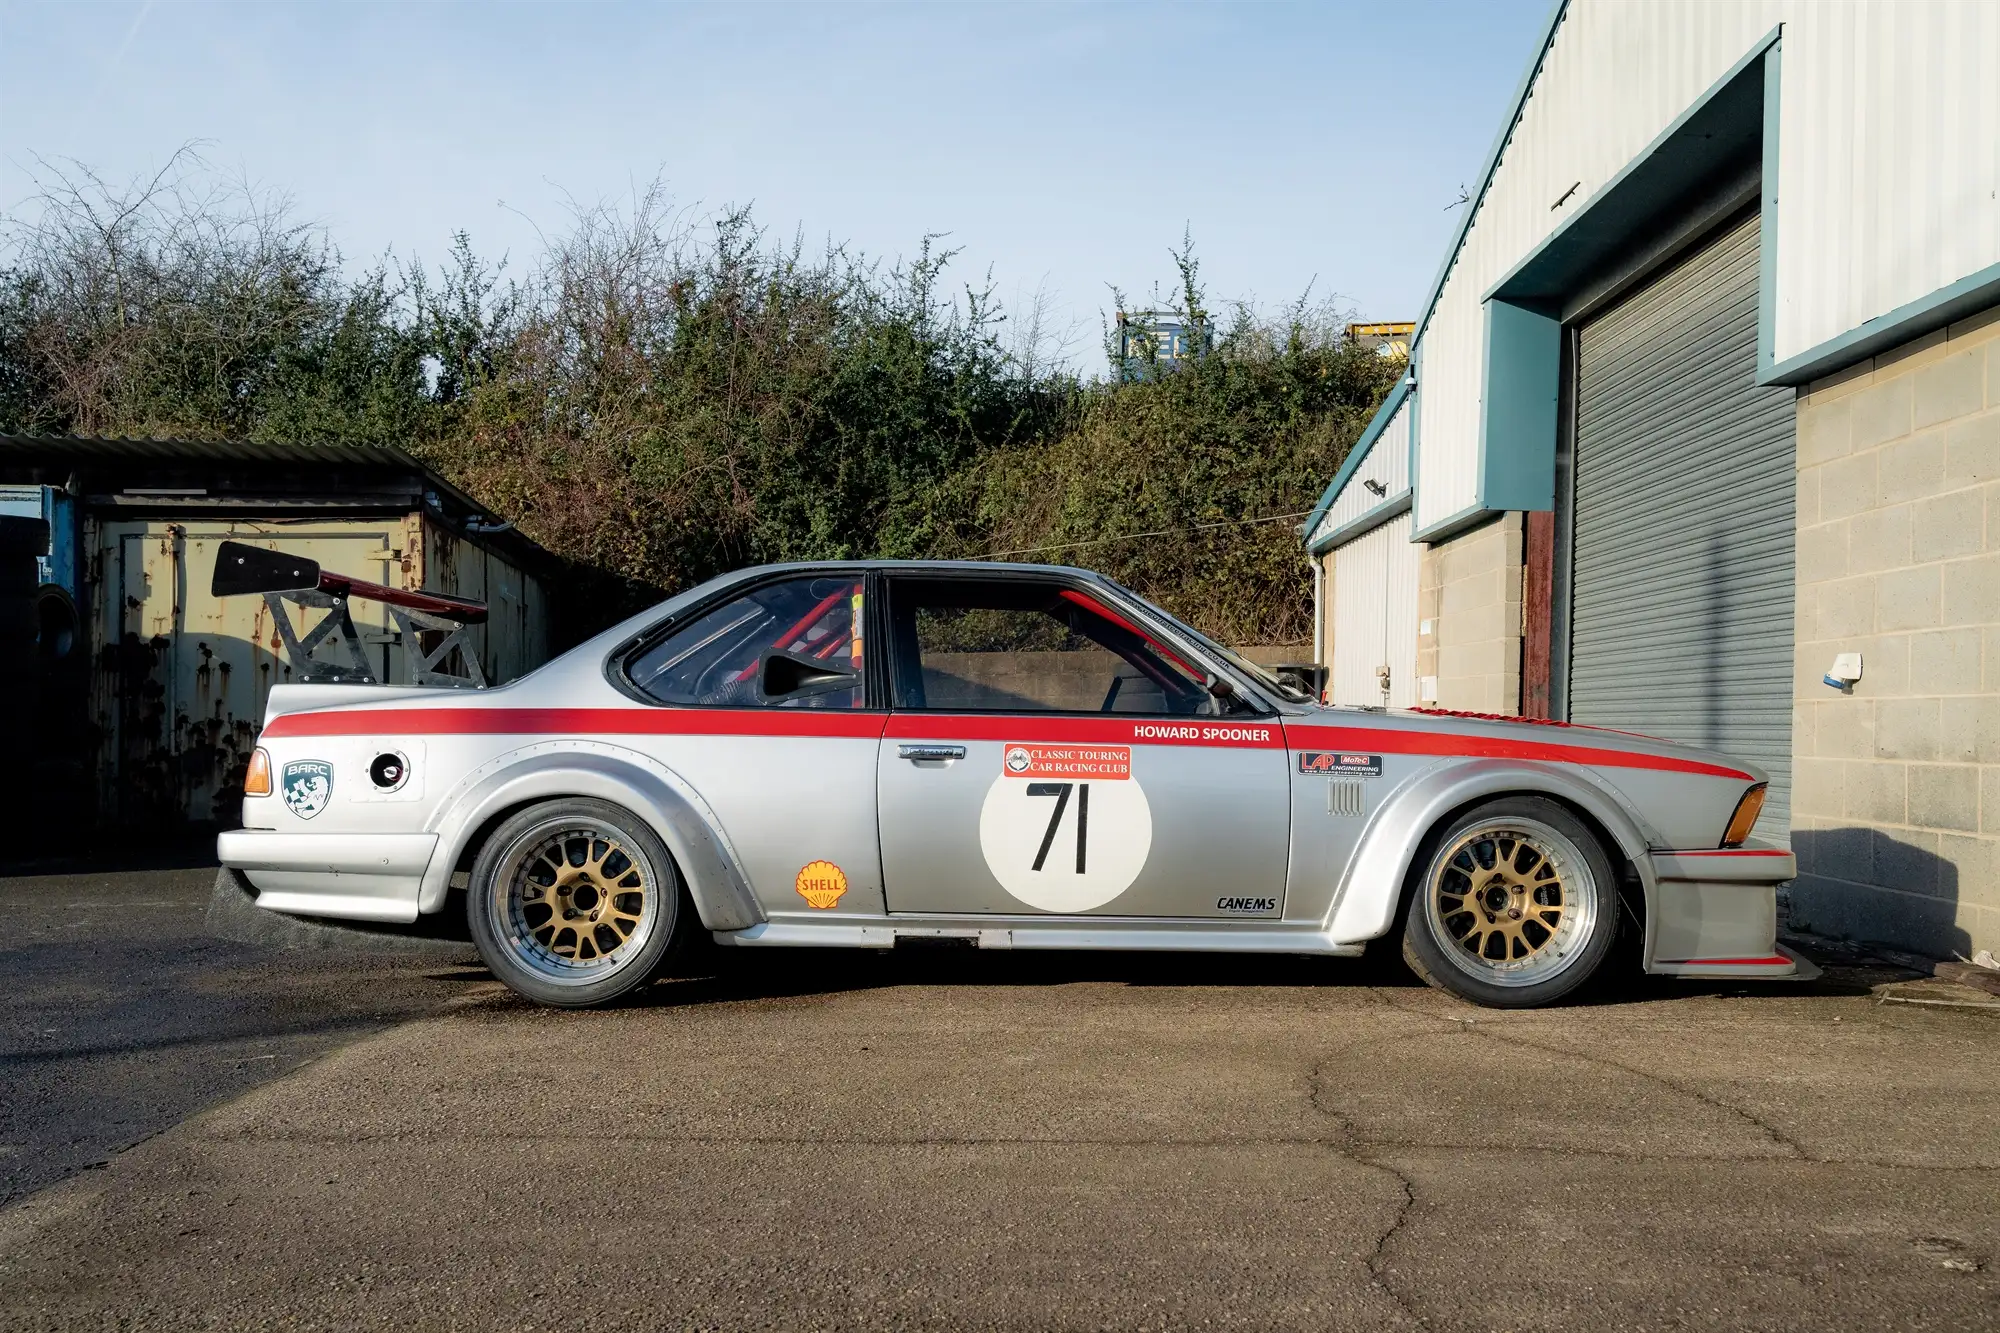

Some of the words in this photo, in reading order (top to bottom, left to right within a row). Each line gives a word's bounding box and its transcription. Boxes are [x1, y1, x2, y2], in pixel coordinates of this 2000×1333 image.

[1134, 725, 1199, 739] HOWARD
[1202, 728, 1270, 741] SPOONER
[1030, 749, 1076, 760] CLASSIC
[1078, 751, 1128, 761] TOURING
[1301, 752, 1335, 770] LAP
[1343, 756, 1368, 764] MoTeC
[287, 763, 328, 776] BARC
[1030, 762, 1053, 772] CAR
[1055, 763, 1097, 773] RACING
[1099, 764, 1128, 773] CLUB
[1330, 765, 1379, 773] ENGINEERING
[1026, 782, 1090, 875] 71
[802, 878, 841, 890] SHELL
[1217, 897, 1276, 909] CANEMS
